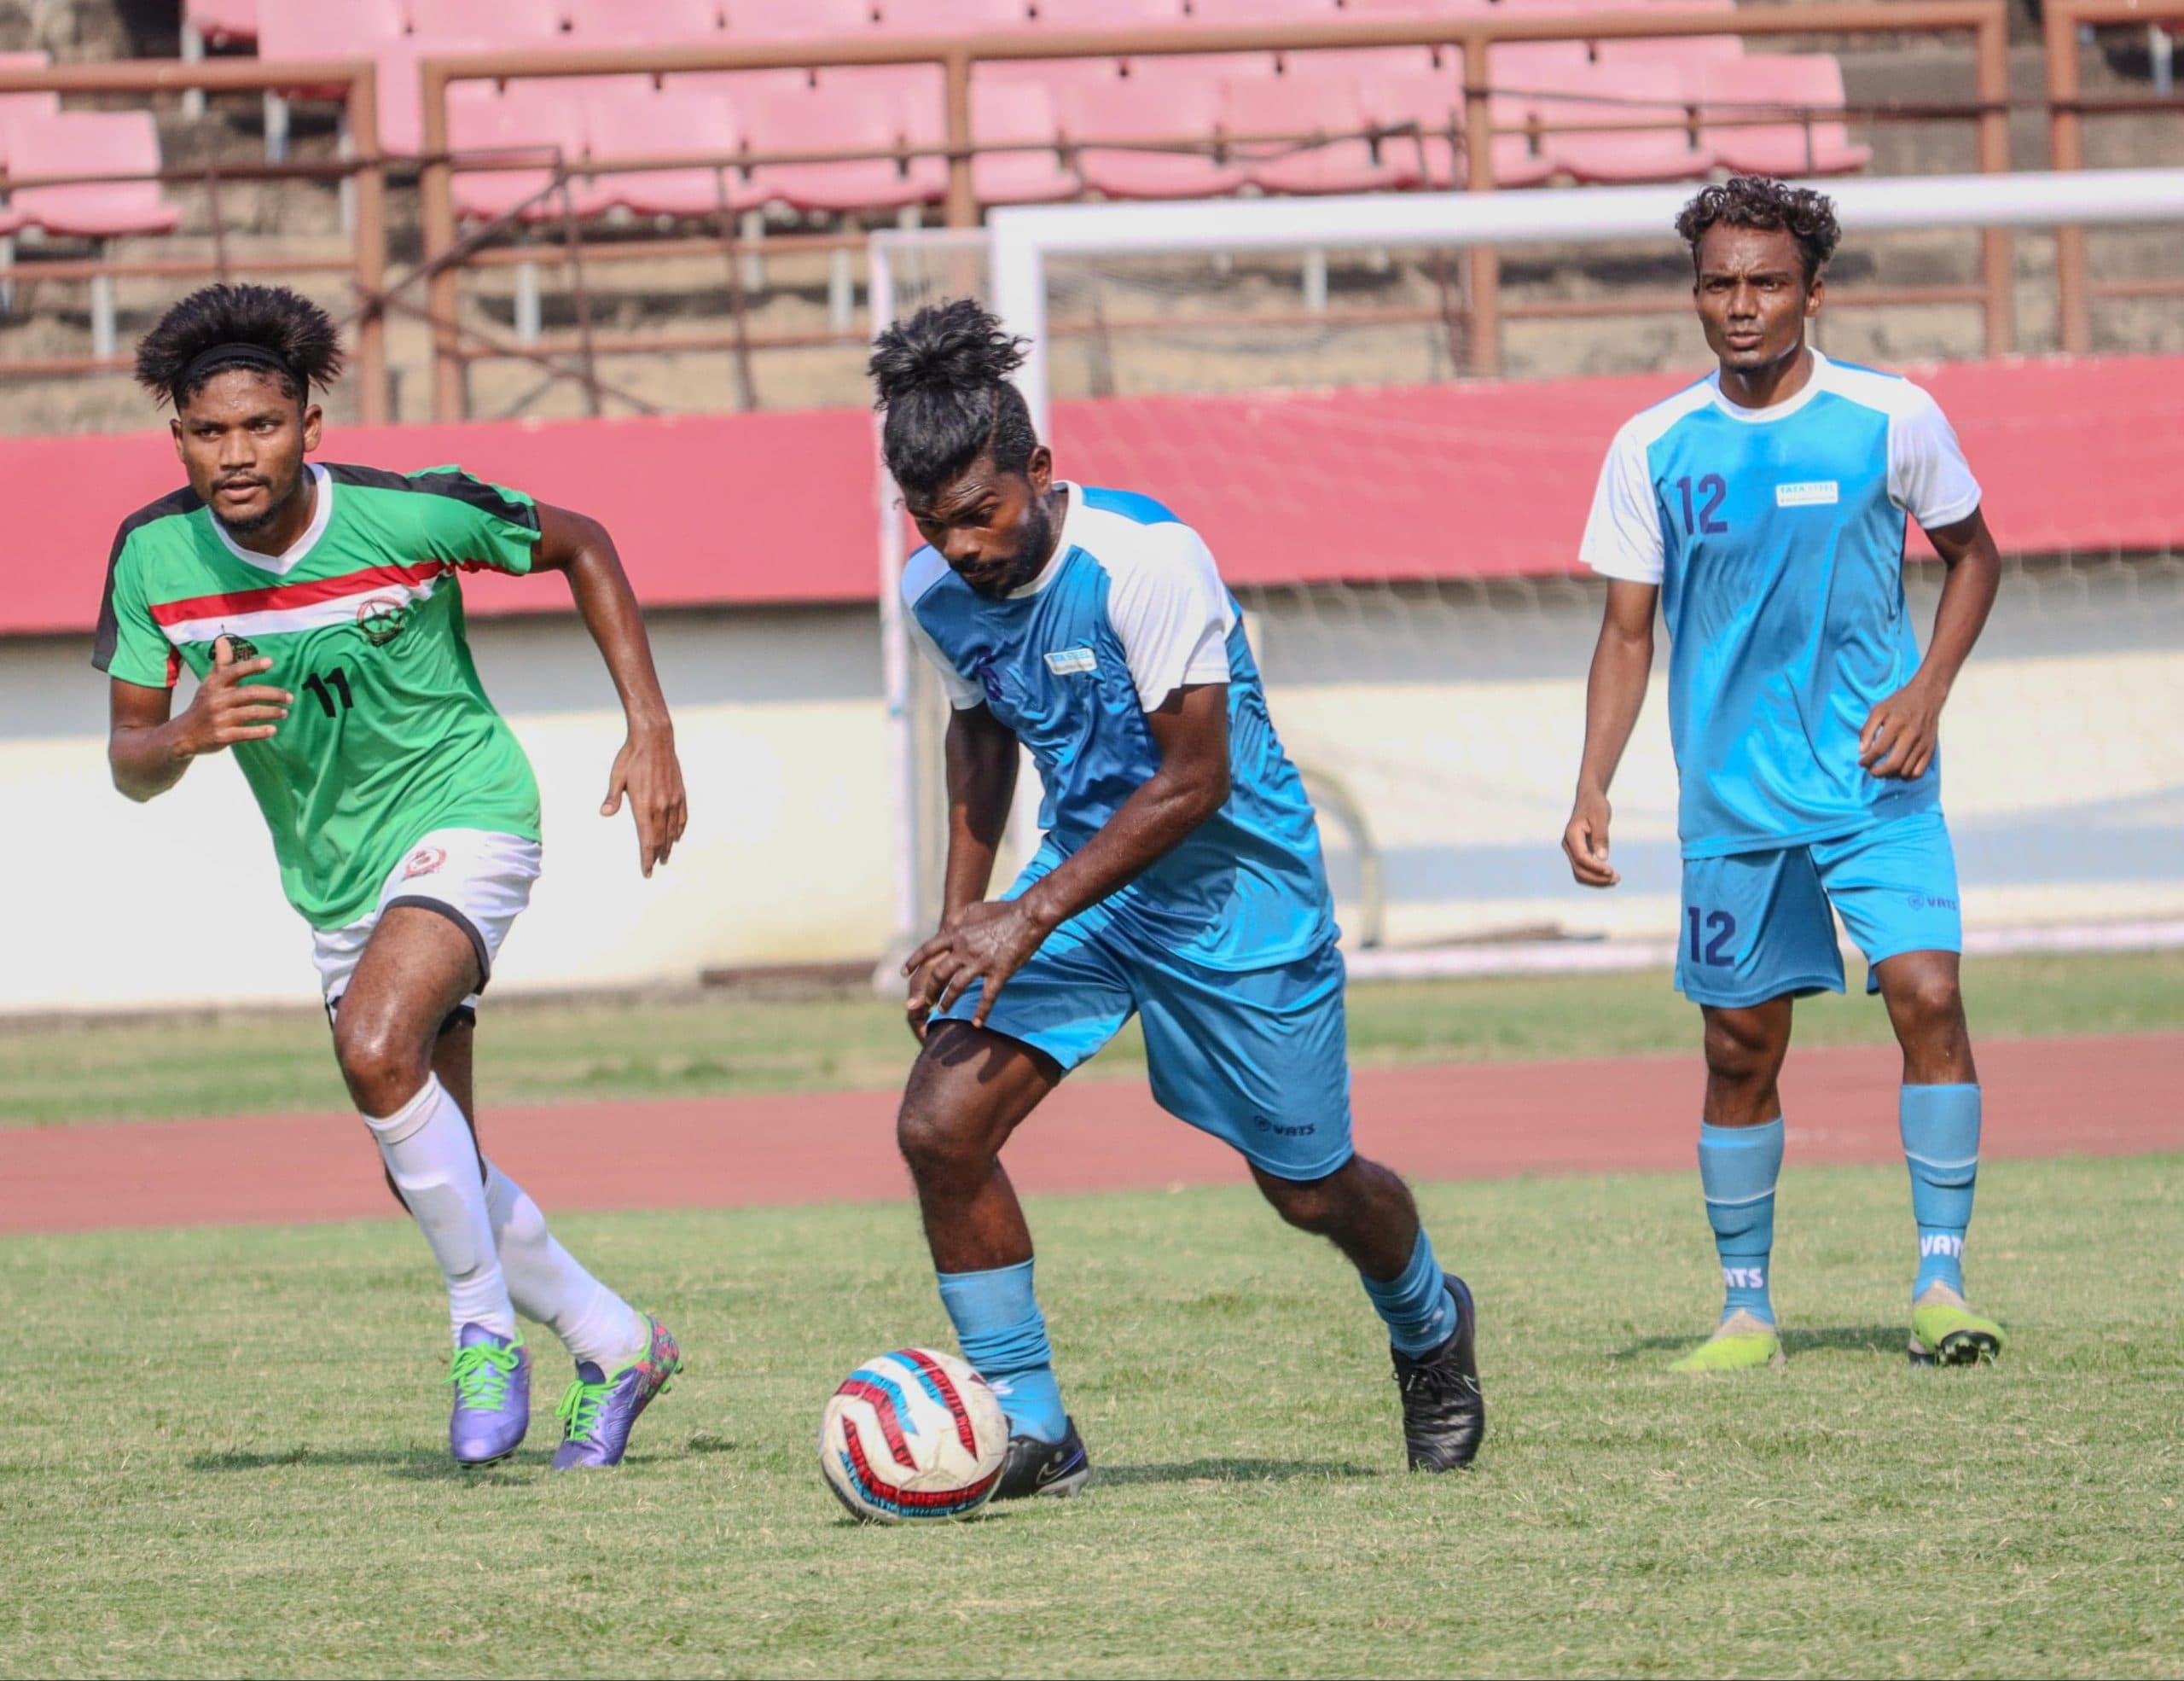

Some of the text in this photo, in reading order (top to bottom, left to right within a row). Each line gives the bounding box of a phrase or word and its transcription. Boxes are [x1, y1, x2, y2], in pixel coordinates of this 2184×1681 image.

[1676, 474, 1728, 536] 12
[302, 667, 353, 718] 11
[1687, 906, 1736, 967] 12
[1273, 1123, 1316, 1137] VATS
